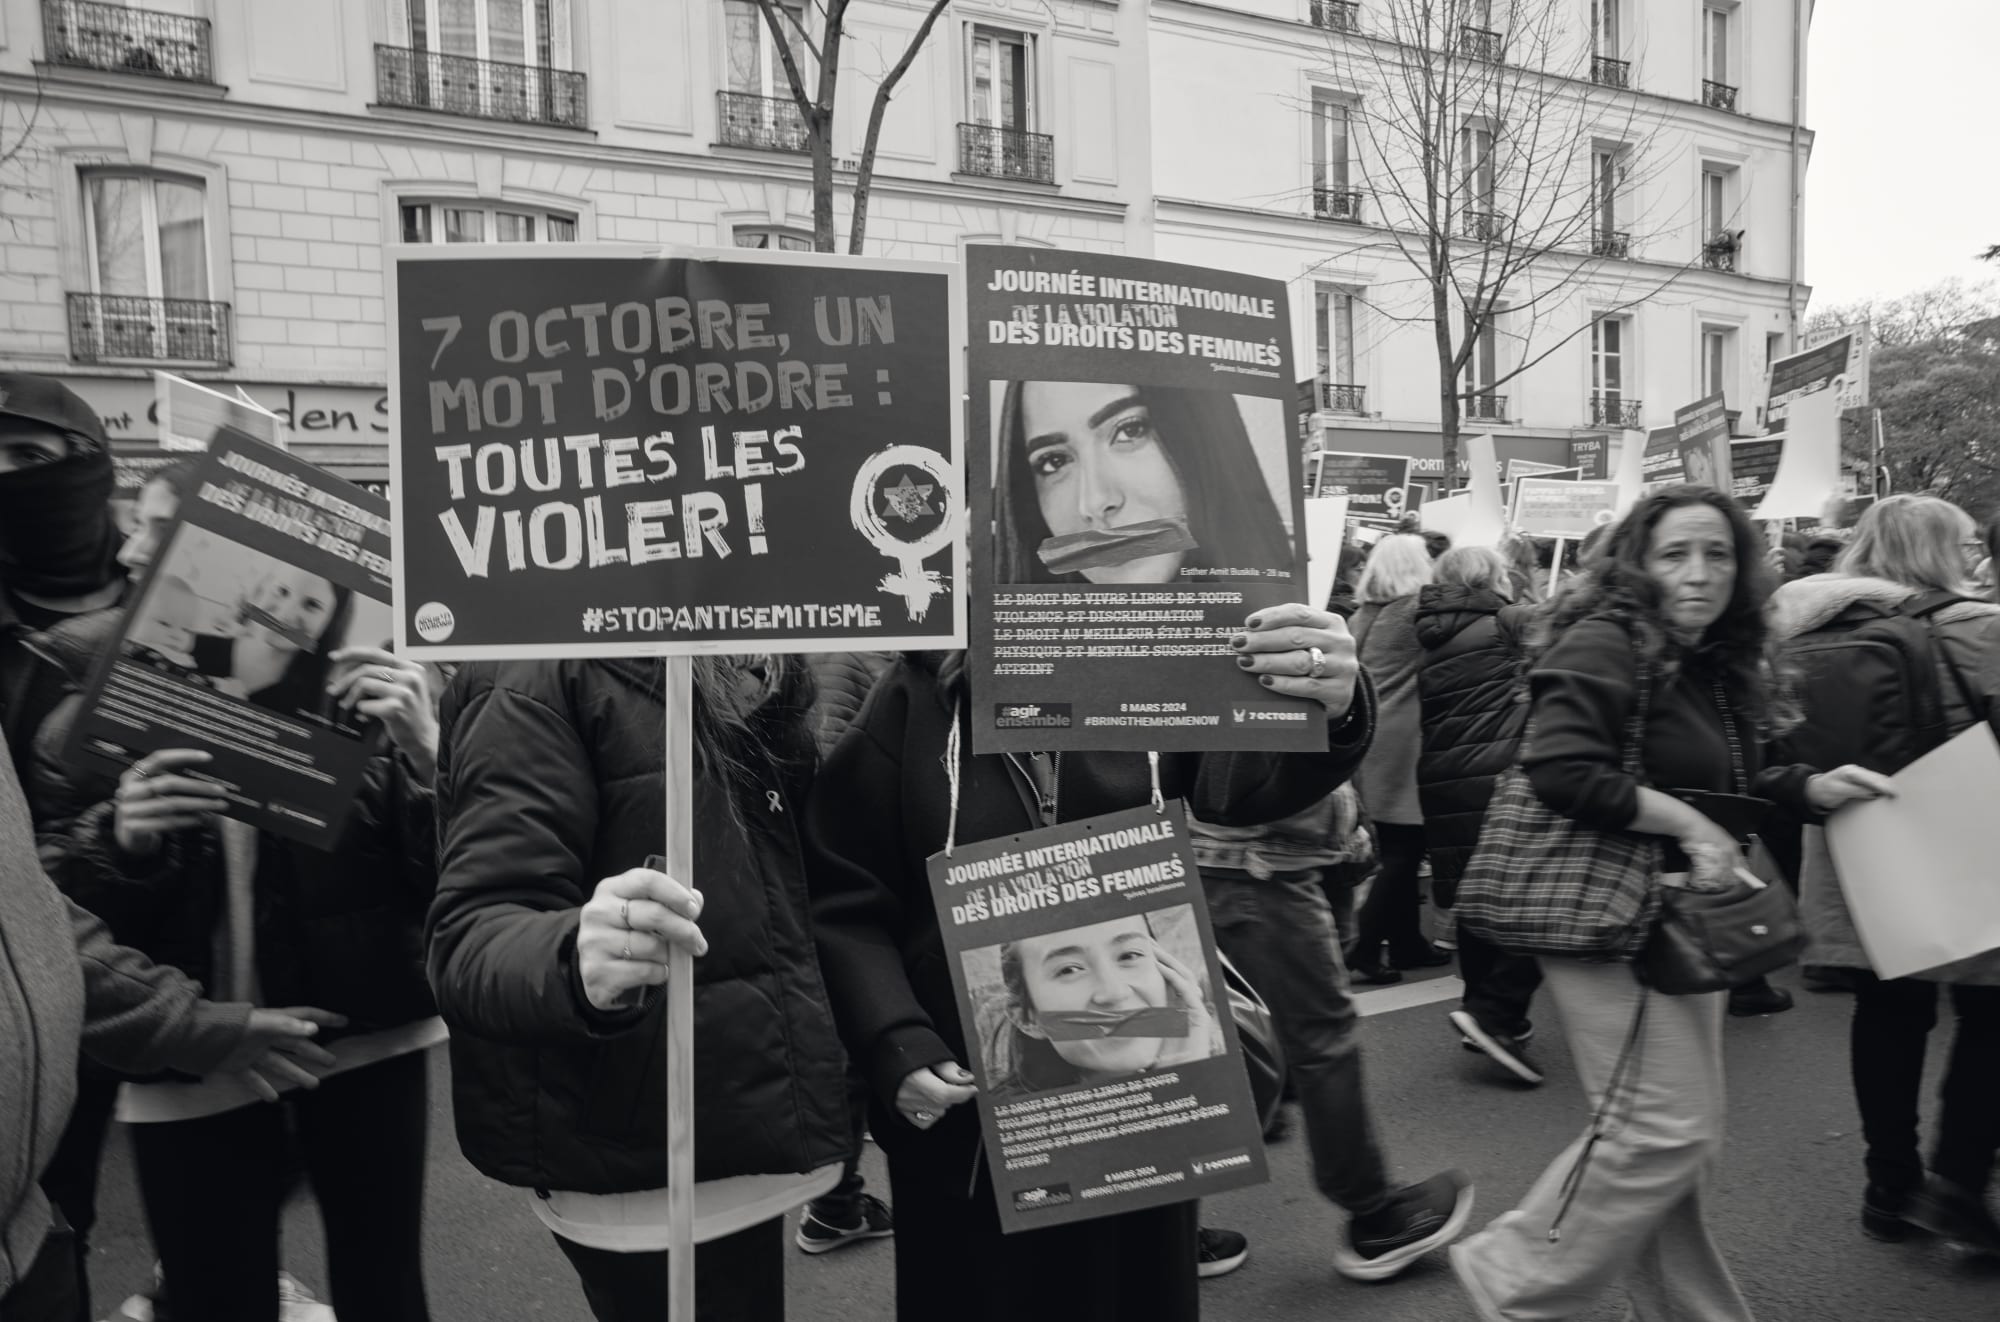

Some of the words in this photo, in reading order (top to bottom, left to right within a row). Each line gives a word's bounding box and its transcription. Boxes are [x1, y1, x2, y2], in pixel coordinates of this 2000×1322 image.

[988, 270, 1096, 296] JOURNÉE
[1100, 277, 1275, 318] INTERNATIONALE
[422, 316, 462, 371] 7
[489, 297, 790, 364] OCTOBRE,
[814, 295, 895, 346] UN
[989, 320, 1039, 345] DES
[1045, 323, 1134, 350] DROITS
[1139, 329, 1184, 355] DES
[429, 369, 563, 434] MOT
[1572, 440, 1601, 452] TRYBA
[435, 431, 677, 500] TOUTES
[700, 425, 806, 480] LES
[1181, 567, 1208, 576] Esther
[1209, 567, 1229, 576] Amit
[993, 594, 1012, 605] LE
[1016, 593, 1060, 605] DROIT
[1062, 593, 1081, 605] DE
[1083, 593, 1128, 605] VIVRE
[1131, 592, 1174, 604] LIBRE
[1176, 592, 1196, 604] DE
[1198, 592, 1242, 604] TOUTE
[582, 604, 882, 634] #STOPANTISEMITISME
[993, 611, 1064, 623] VIOLENCE
[1067, 611, 1086, 622] ET
[1088, 610, 1204, 622] DISCRIMINATION
[993, 629, 1012, 640] LE
[1016, 629, 1060, 640] DROIT
[1062, 629, 1081, 640] AU
[1083, 627, 1154, 640] MEILLEUR
[1157, 625, 1192, 639] ÉTAT
[1194, 627, 1213, 639] DE
[993, 646, 1062, 658] PHYSIQUE
[1065, 645, 1084, 657] ET
[1087, 645, 1150, 657] MENTALE
[993, 663, 1055, 675] ATTEINT
[1002, 705, 1041, 718] #agir
[1120, 703, 1127, 712] 8
[1129, 703, 1160, 712] MARS
[1162, 702, 1187, 712] 2024
[996, 714, 1071, 727] ensemble
[1084, 716, 1220, 726] #BRINGTHEMHOMENOW
[1258, 712, 1307, 720] OCTOBRE
[945, 852, 1024, 885] JOURNÉE
[1025, 820, 1175, 869] INTERNATIONALE
[952, 898, 990, 925] DES
[992, 886, 1061, 918] DROITS
[1062, 877, 1101, 902] DES
